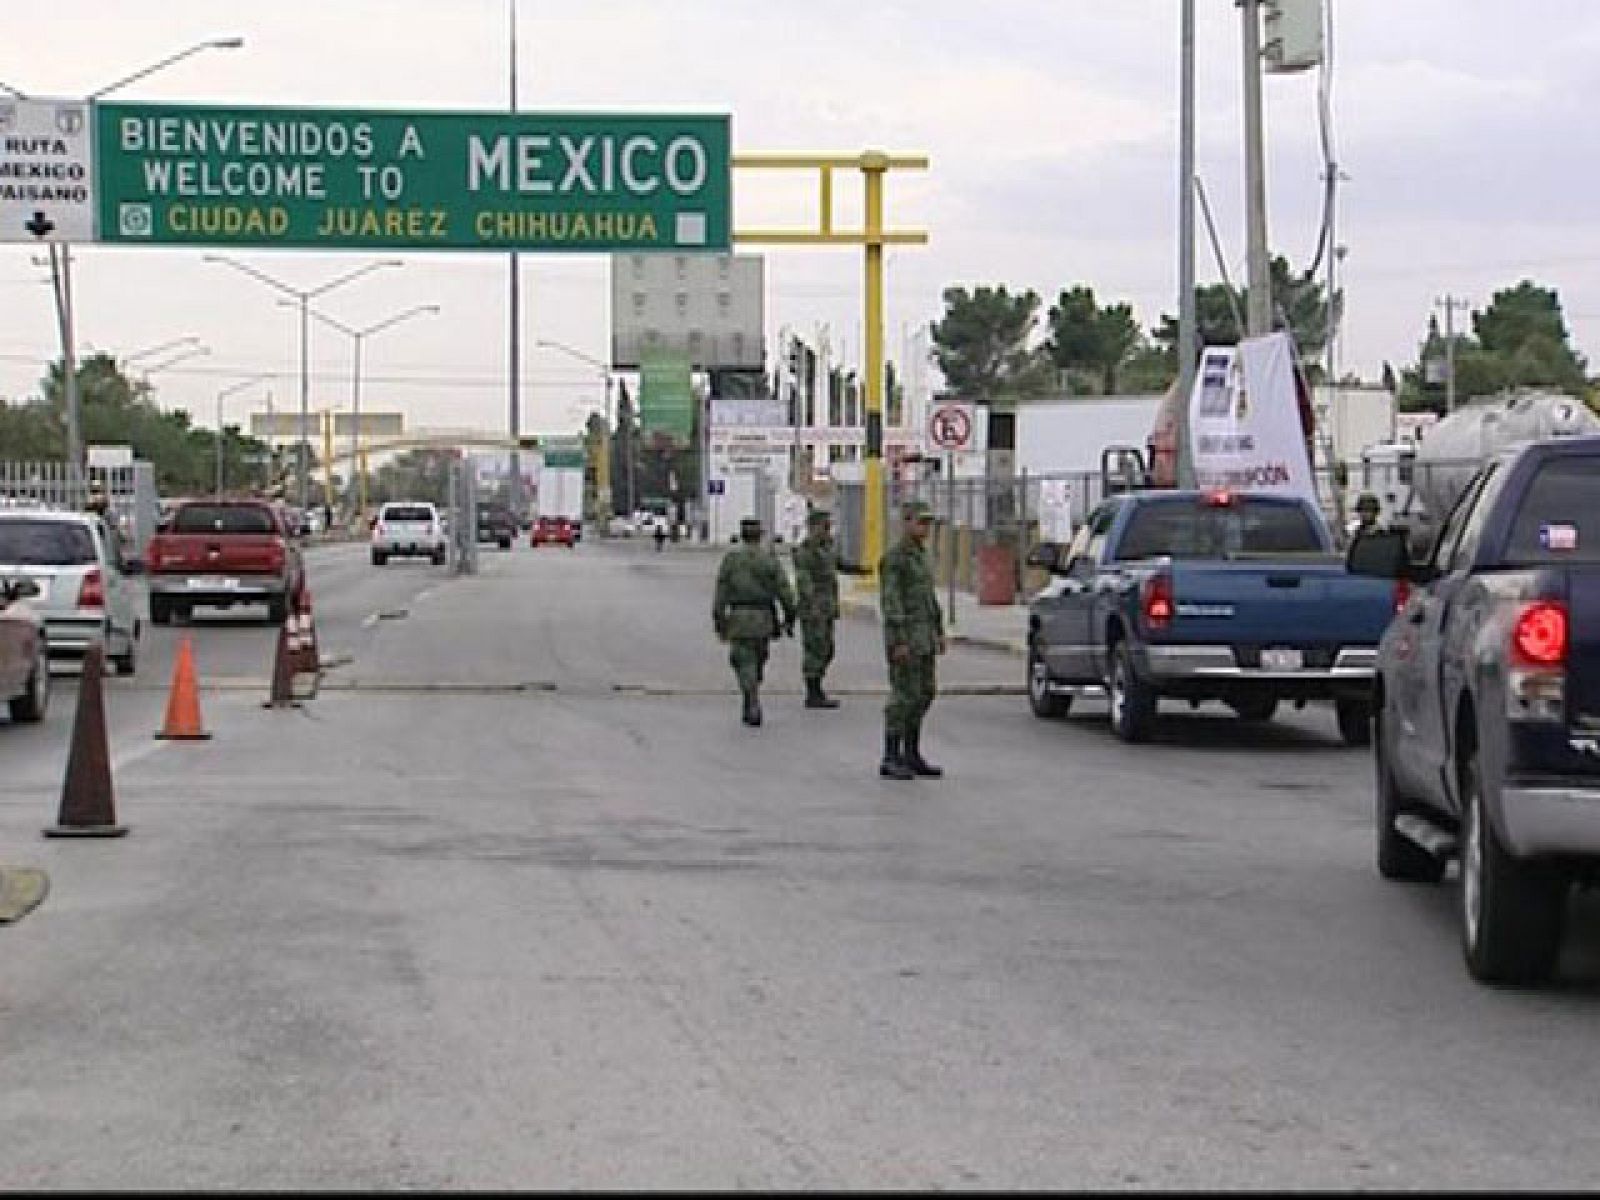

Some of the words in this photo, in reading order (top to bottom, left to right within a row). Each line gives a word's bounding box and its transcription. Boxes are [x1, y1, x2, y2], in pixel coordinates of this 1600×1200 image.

[6, 138, 67, 155] RUTA
[121, 117, 374, 157] BIENVENIDOS
[400, 126, 424, 158] A
[144, 161, 326, 197] WELCOME
[359, 167, 403, 199] TO
[468, 136, 706, 194] MEXICO
[0, 185, 88, 203] AISANO
[168, 205, 289, 234] CIUDAD
[318, 207, 448, 236] JUAREZ
[475, 211, 658, 240] CHIHUAHUA
